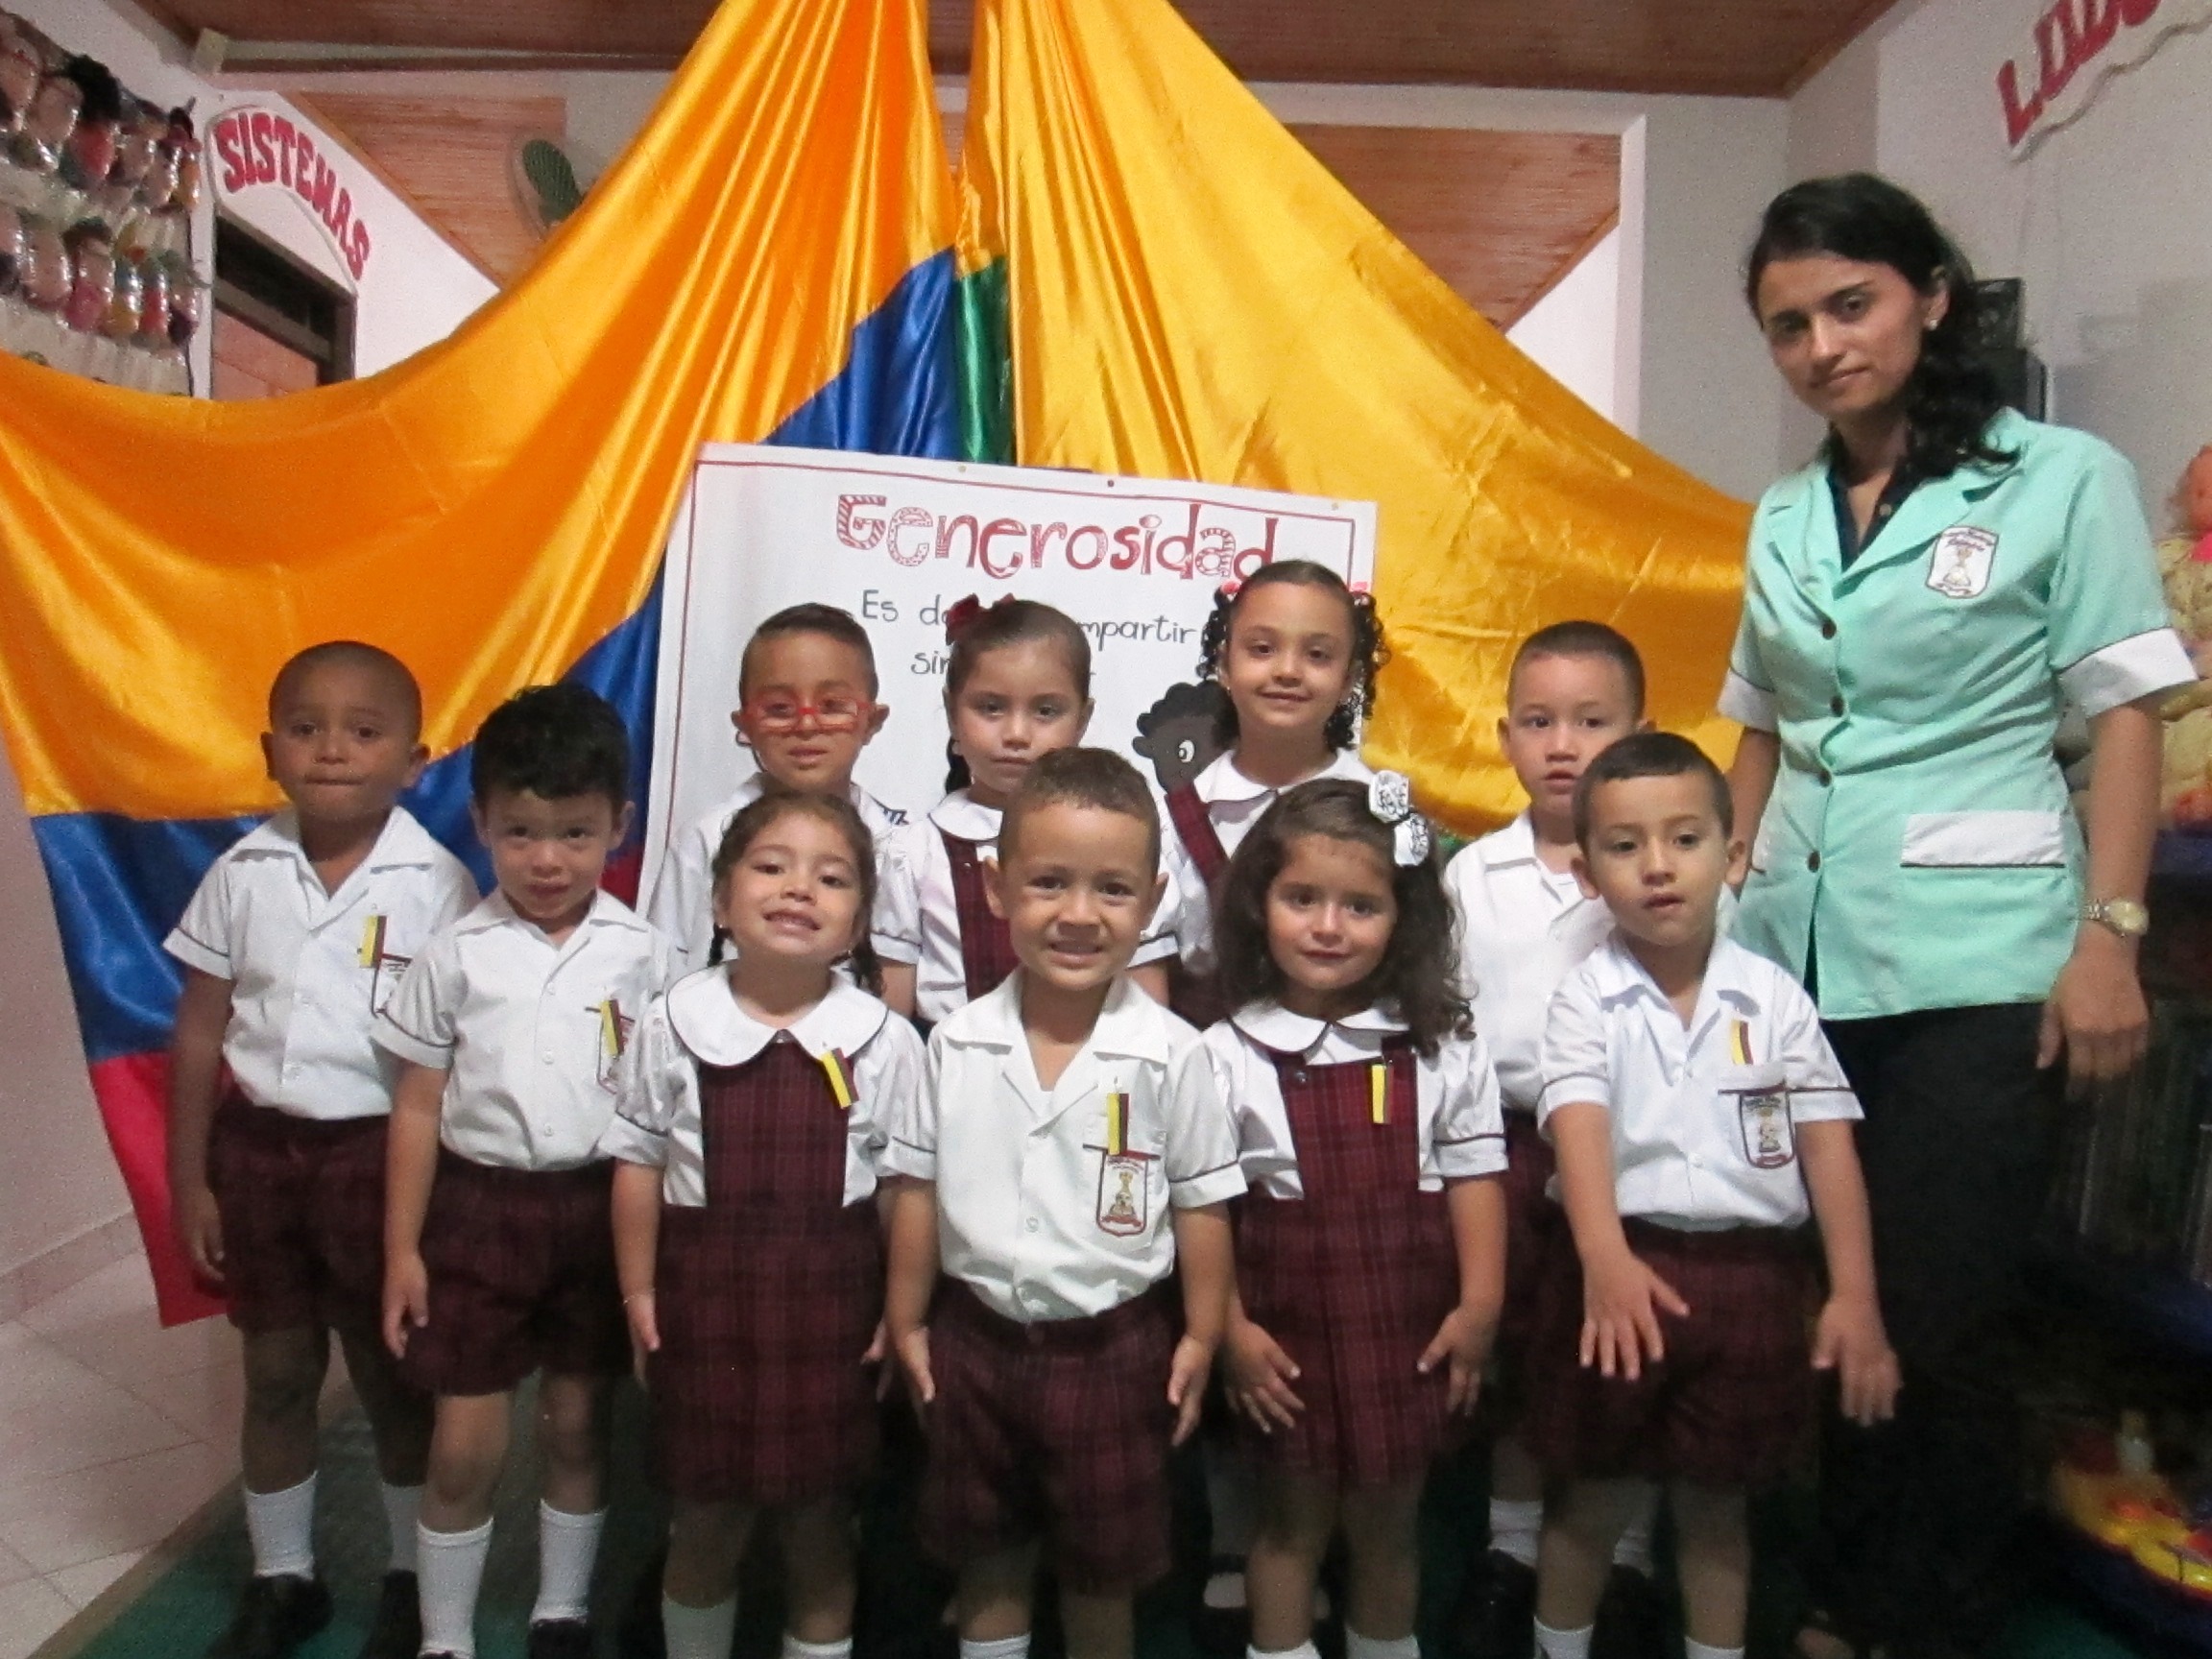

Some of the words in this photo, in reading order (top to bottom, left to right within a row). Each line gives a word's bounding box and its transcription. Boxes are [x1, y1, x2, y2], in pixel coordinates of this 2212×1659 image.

[214, 111, 370, 280] SISTEMAS
[836, 493, 1279, 582] Generosidad
[862, 589, 899, 623] Es
